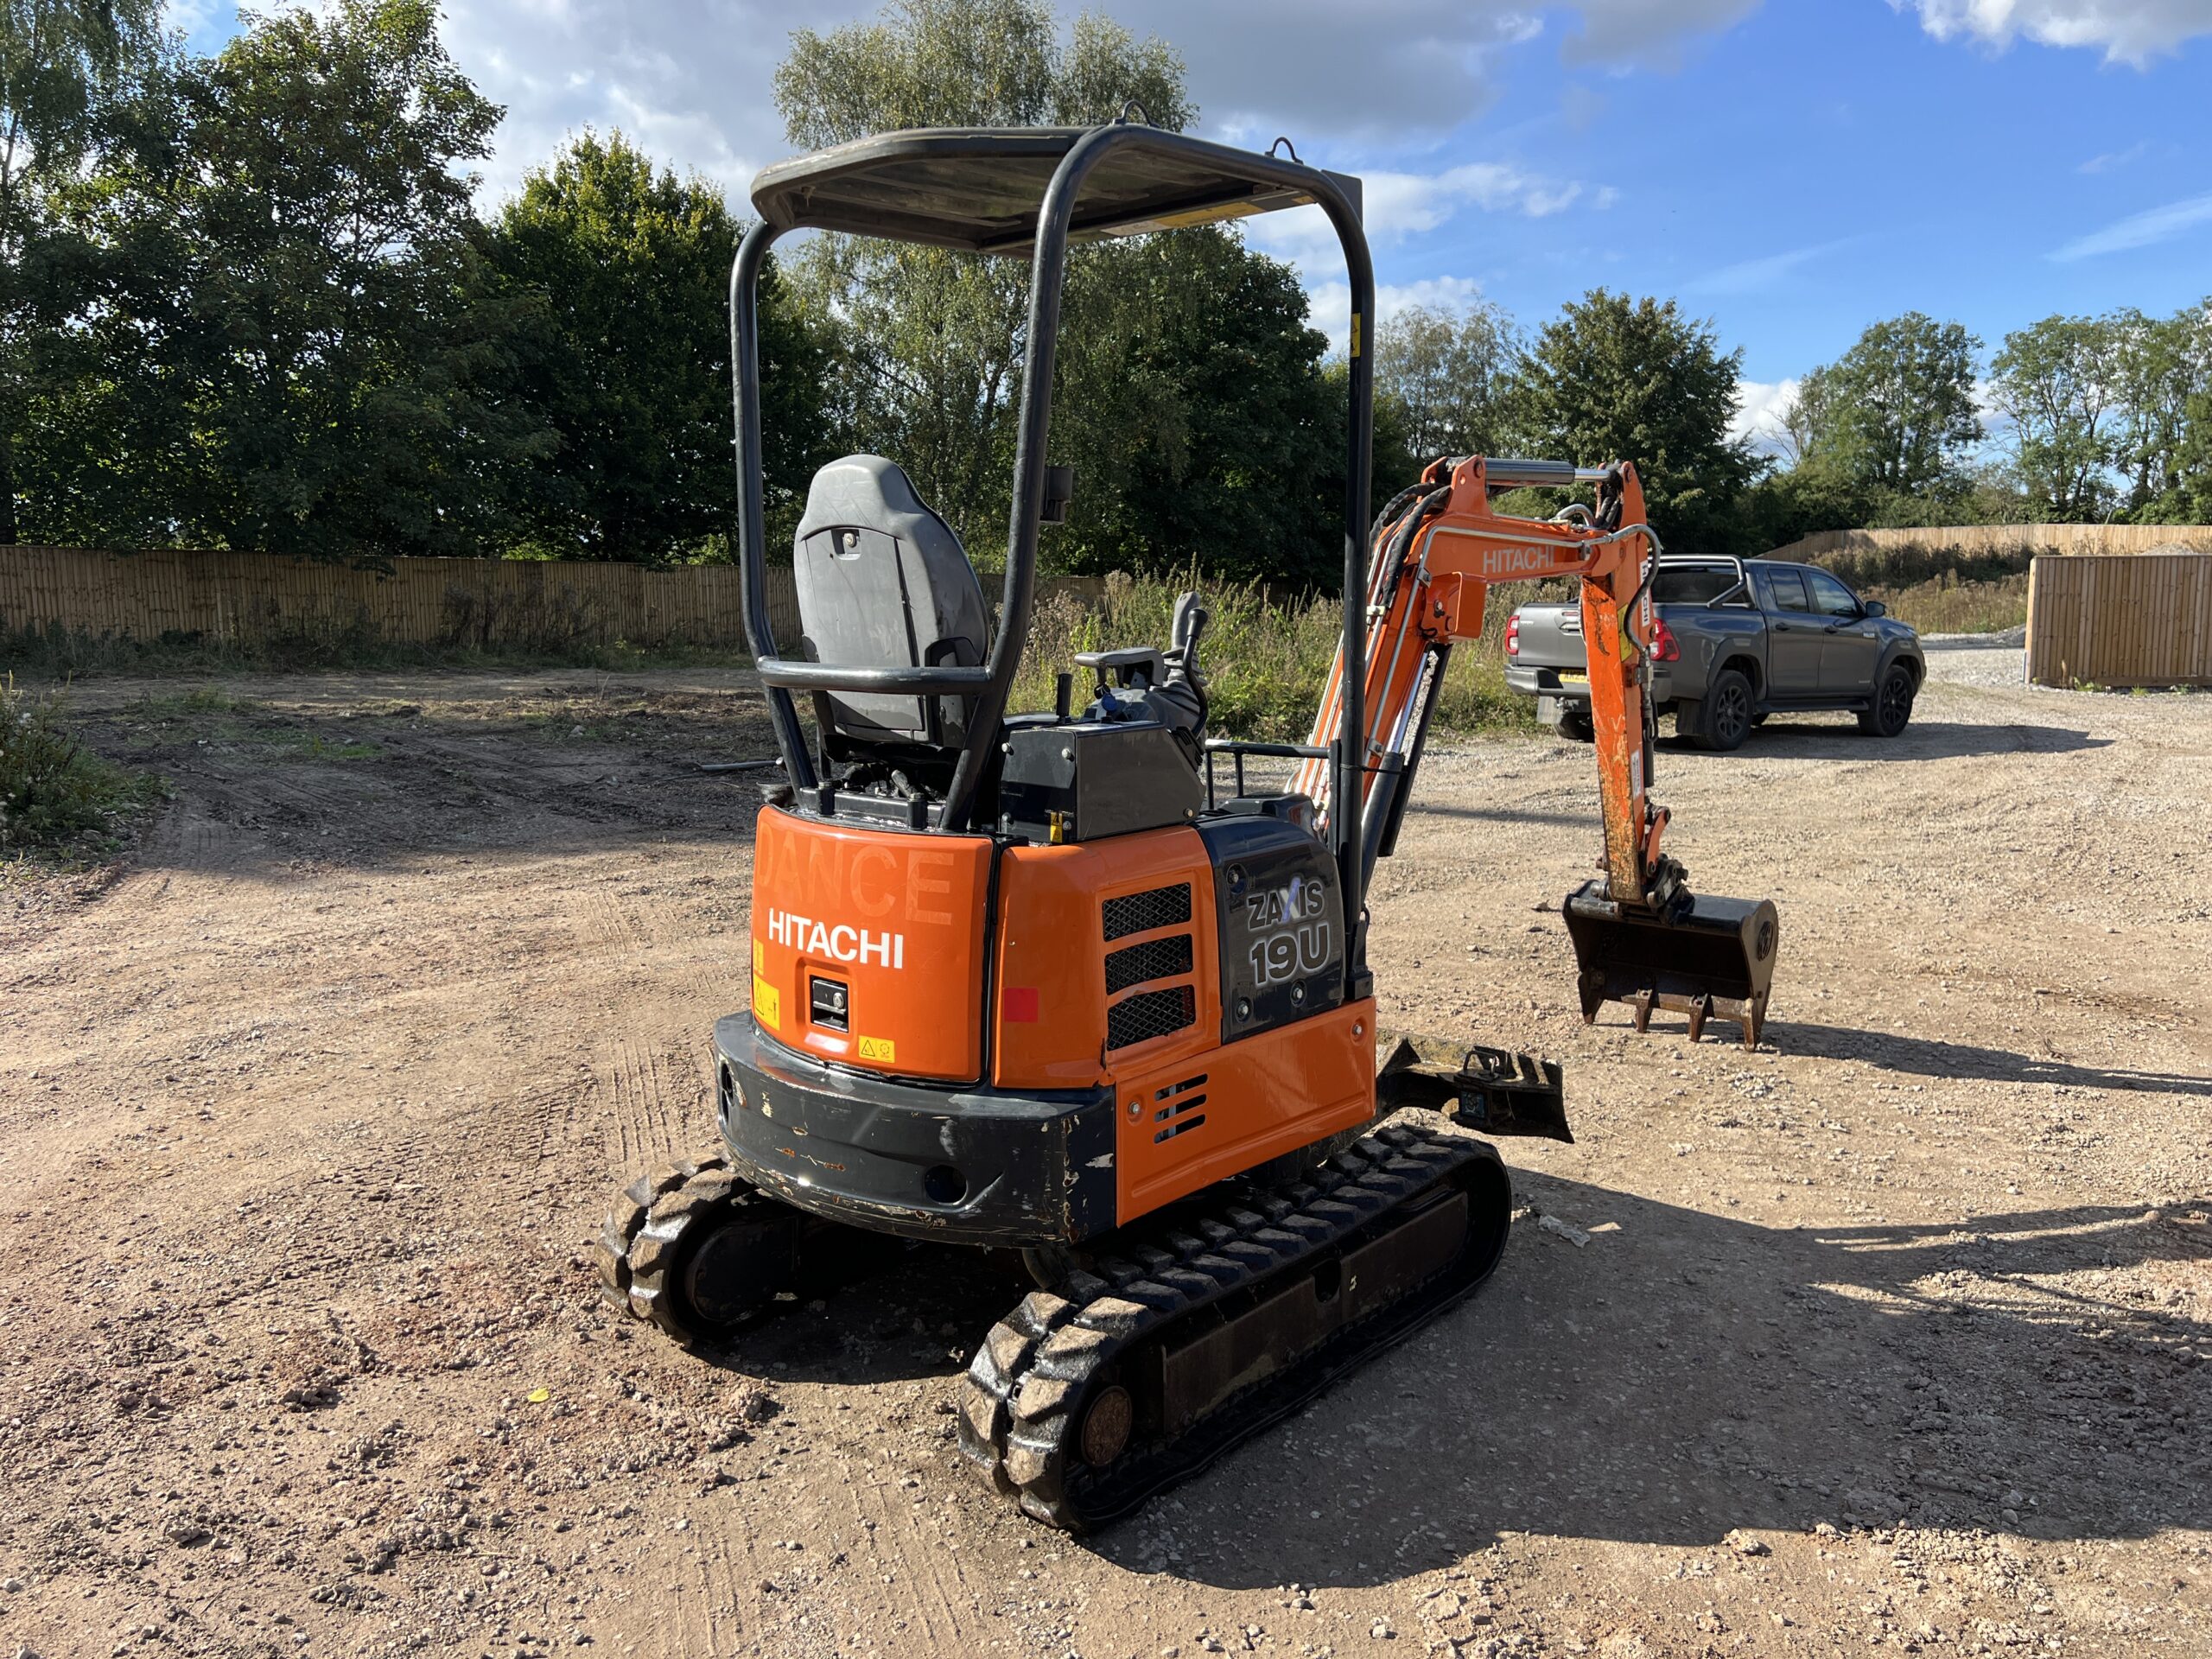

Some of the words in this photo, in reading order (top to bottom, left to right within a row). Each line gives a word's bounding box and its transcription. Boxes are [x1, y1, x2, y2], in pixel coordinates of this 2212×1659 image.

[1483, 545, 1554, 574] HITACHI
[1248, 878, 1324, 930] ZAXIS
[768, 908, 904, 969] HITACHI
[1251, 925, 1331, 985] 19U
